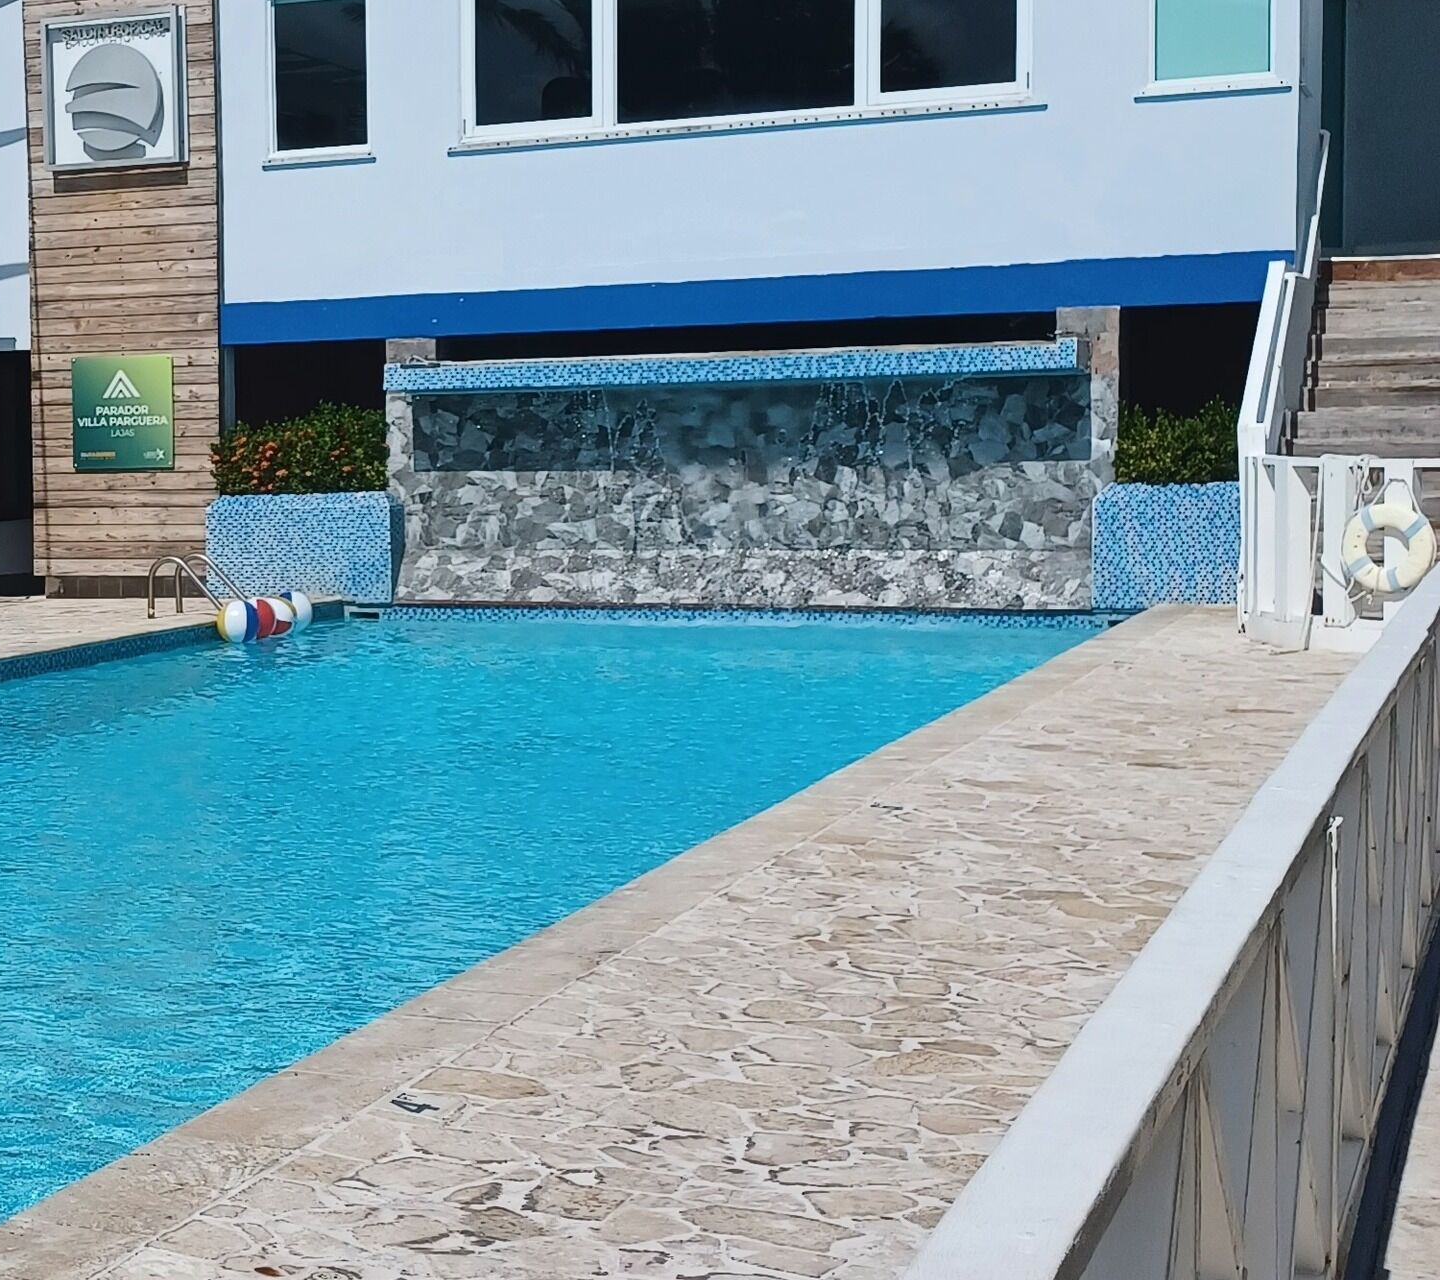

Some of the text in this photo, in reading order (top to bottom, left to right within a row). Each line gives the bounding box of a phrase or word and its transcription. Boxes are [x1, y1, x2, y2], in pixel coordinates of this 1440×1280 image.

[95, 405, 149, 416] PARADOR
[77, 415, 169, 427] VILLA PARGUERA
[111, 428, 135, 437] LAJAS
